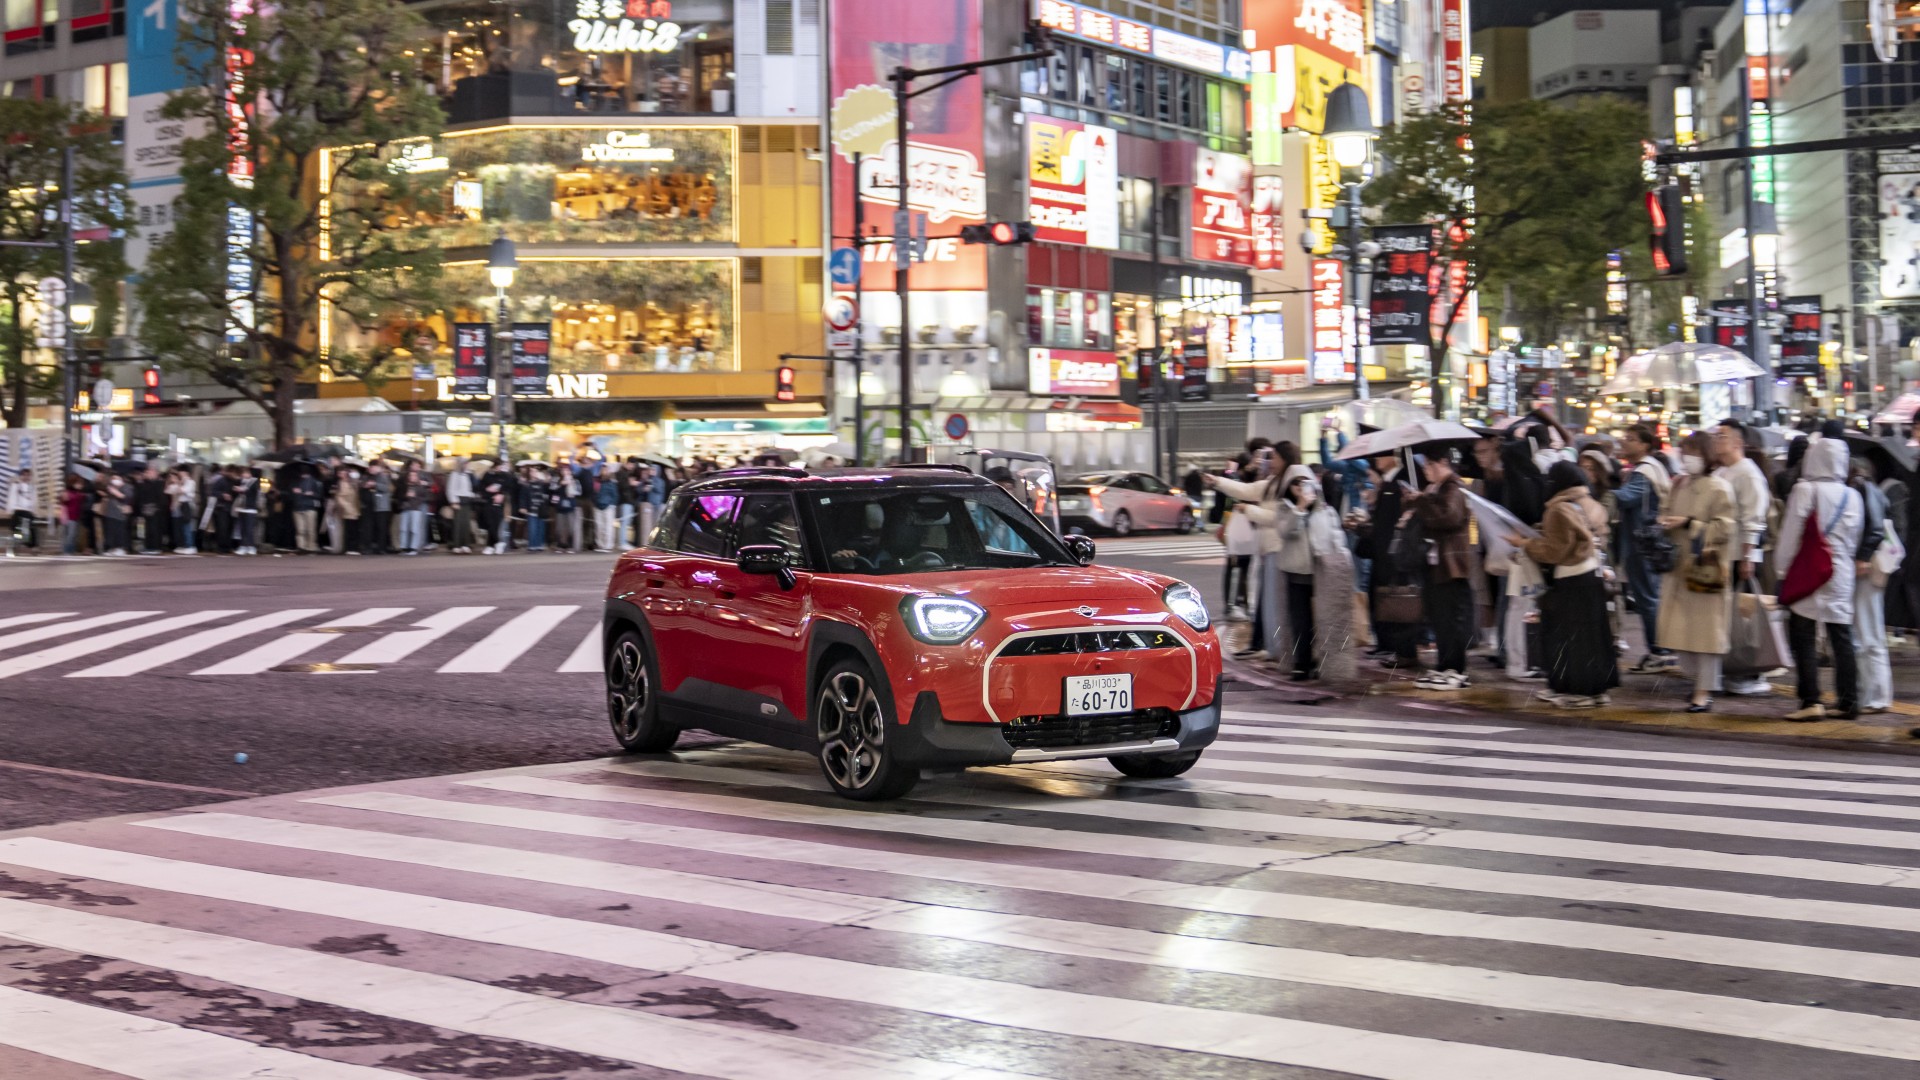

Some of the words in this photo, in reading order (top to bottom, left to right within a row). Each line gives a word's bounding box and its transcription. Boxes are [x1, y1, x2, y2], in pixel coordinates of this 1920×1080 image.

[1180, 275, 1242, 315] LUSH
[1154, 634, 1164, 645] S
[1082, 690, 1128, 711] 60-70
